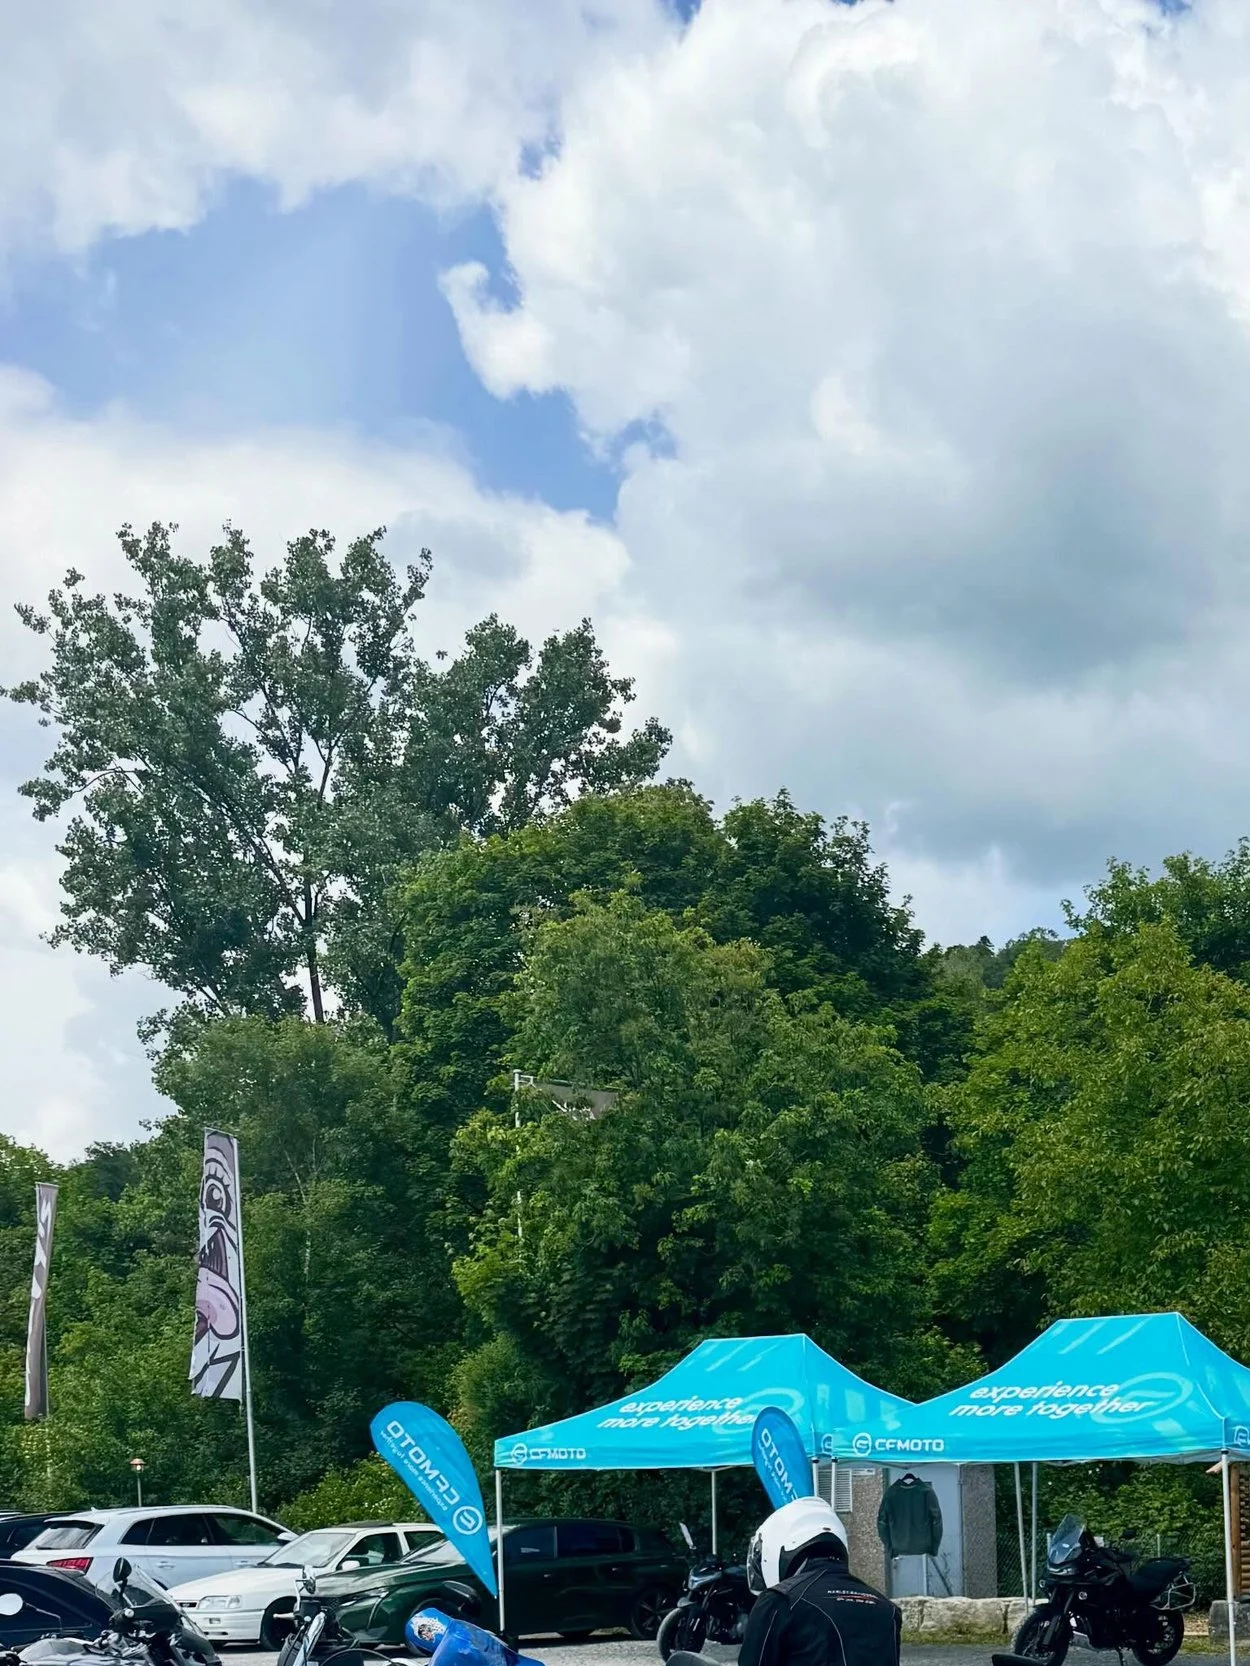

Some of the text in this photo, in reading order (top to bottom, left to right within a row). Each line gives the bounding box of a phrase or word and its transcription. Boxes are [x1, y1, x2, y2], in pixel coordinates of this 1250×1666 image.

[970, 1381, 1120, 1403] experience
[619, 1395, 743, 1416] experience
[950, 1398, 1152, 1420] more together
[597, 1415, 660, 1429] more
[530, 1447, 587, 1460] CFMOTO
[875, 1438, 945, 1452] CFMOTO
